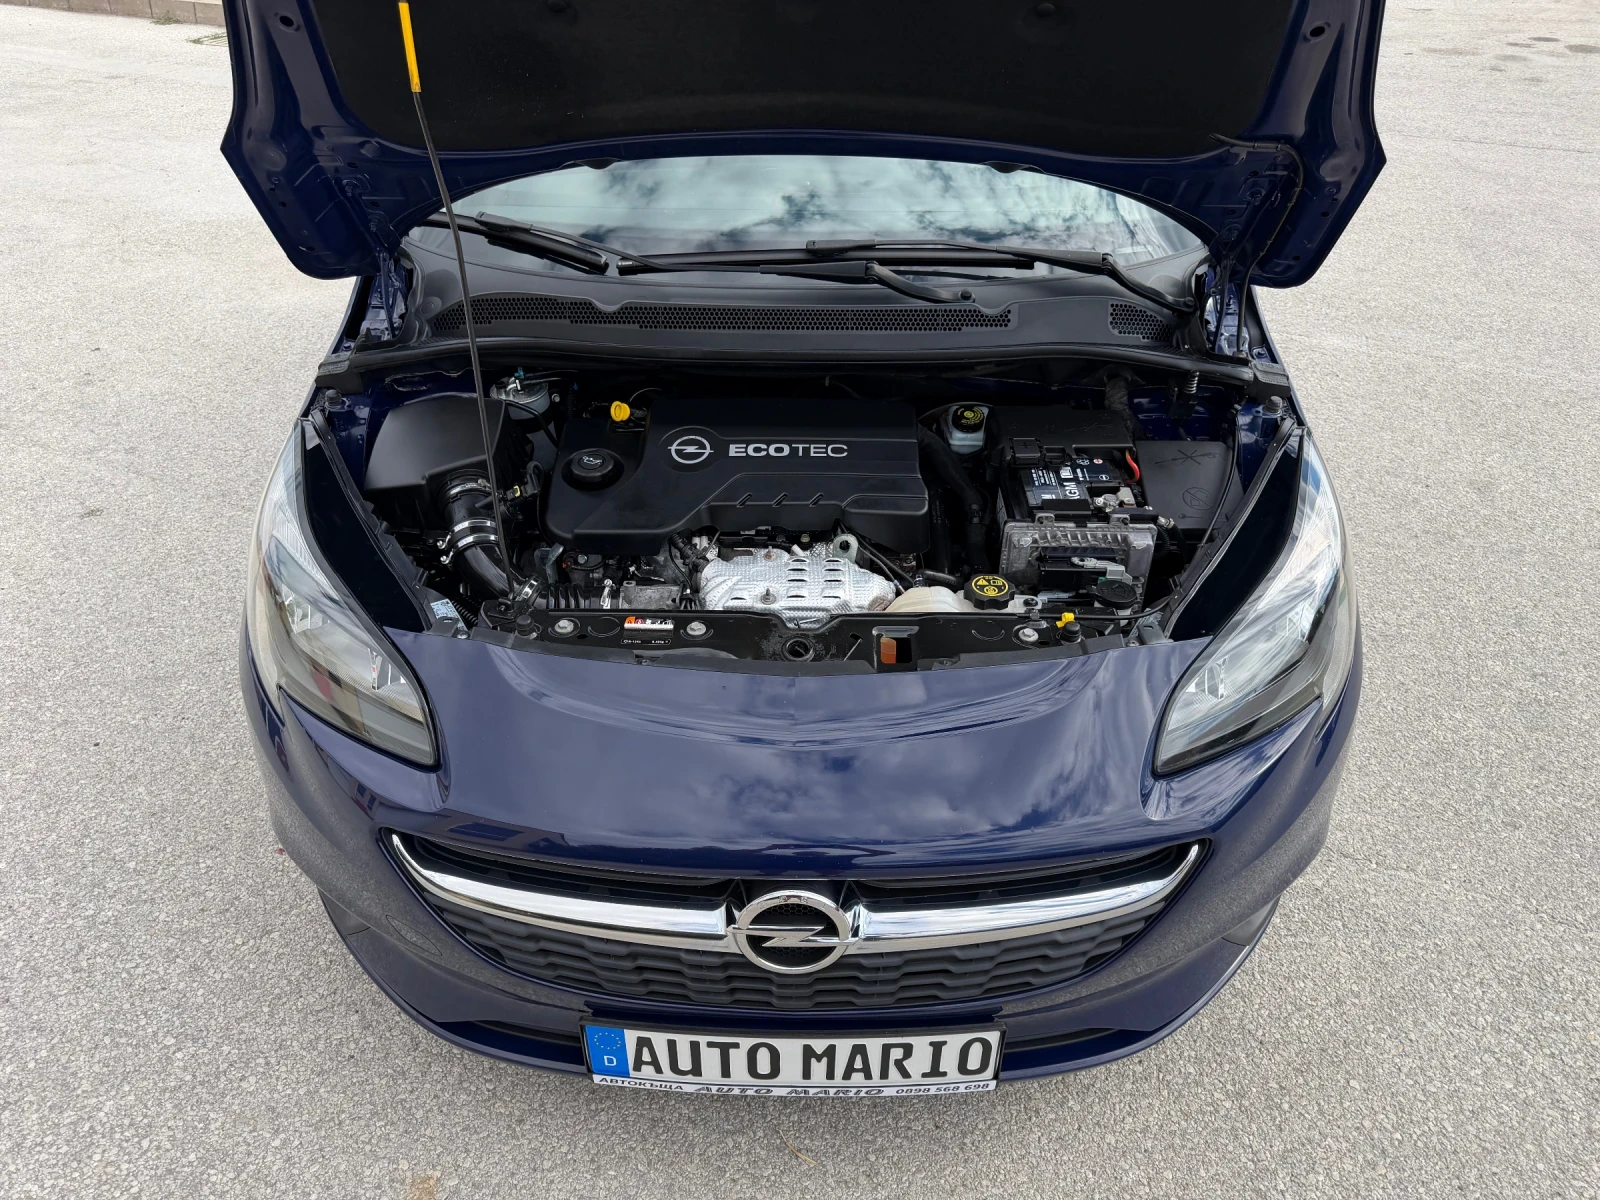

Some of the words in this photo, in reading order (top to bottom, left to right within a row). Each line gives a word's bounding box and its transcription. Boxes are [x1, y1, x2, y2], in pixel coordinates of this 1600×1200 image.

[728, 443, 848, 457] ECOTEC
[603, 1055, 617, 1067] D
[632, 1035, 781, 1080] AUTO
[802, 1036, 993, 1081] MARIO
[693, 1086, 774, 1095] AUTO
[786, 1088, 885, 1096] MARIO
[895, 1087, 931, 1095] 0898
[935, 1085, 960, 1093] 568
[964, 1083, 991, 1092] 698
